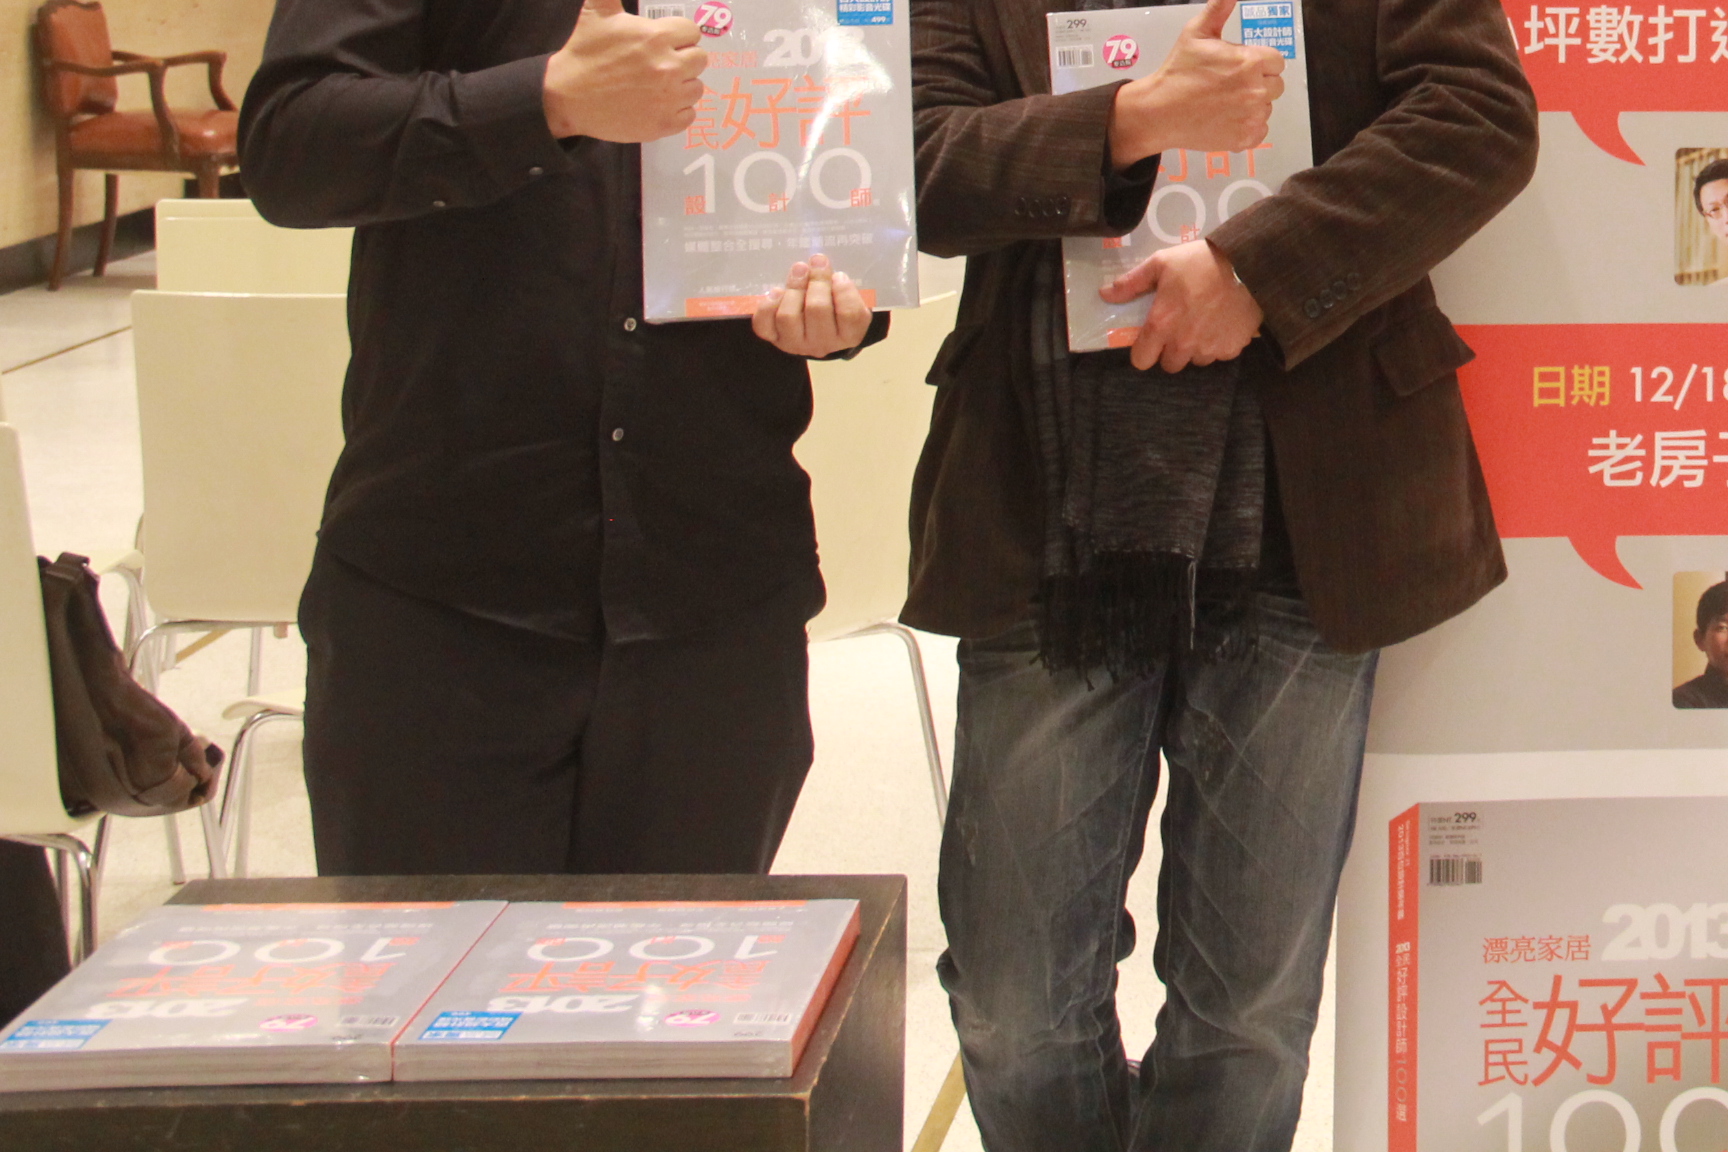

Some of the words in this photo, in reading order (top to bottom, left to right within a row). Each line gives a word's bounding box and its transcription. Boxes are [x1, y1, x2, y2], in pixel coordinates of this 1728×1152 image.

[697, 4, 732, 29] 79
[1067, 19, 1087, 29] 299
[707, 51, 757, 68] 亮家居
[1106, 38, 1136, 63] 79
[683, 148, 872, 214] 100
[1532, 365, 1611, 408] 日期
[1482, 935, 1591, 964] 漂亮家居
